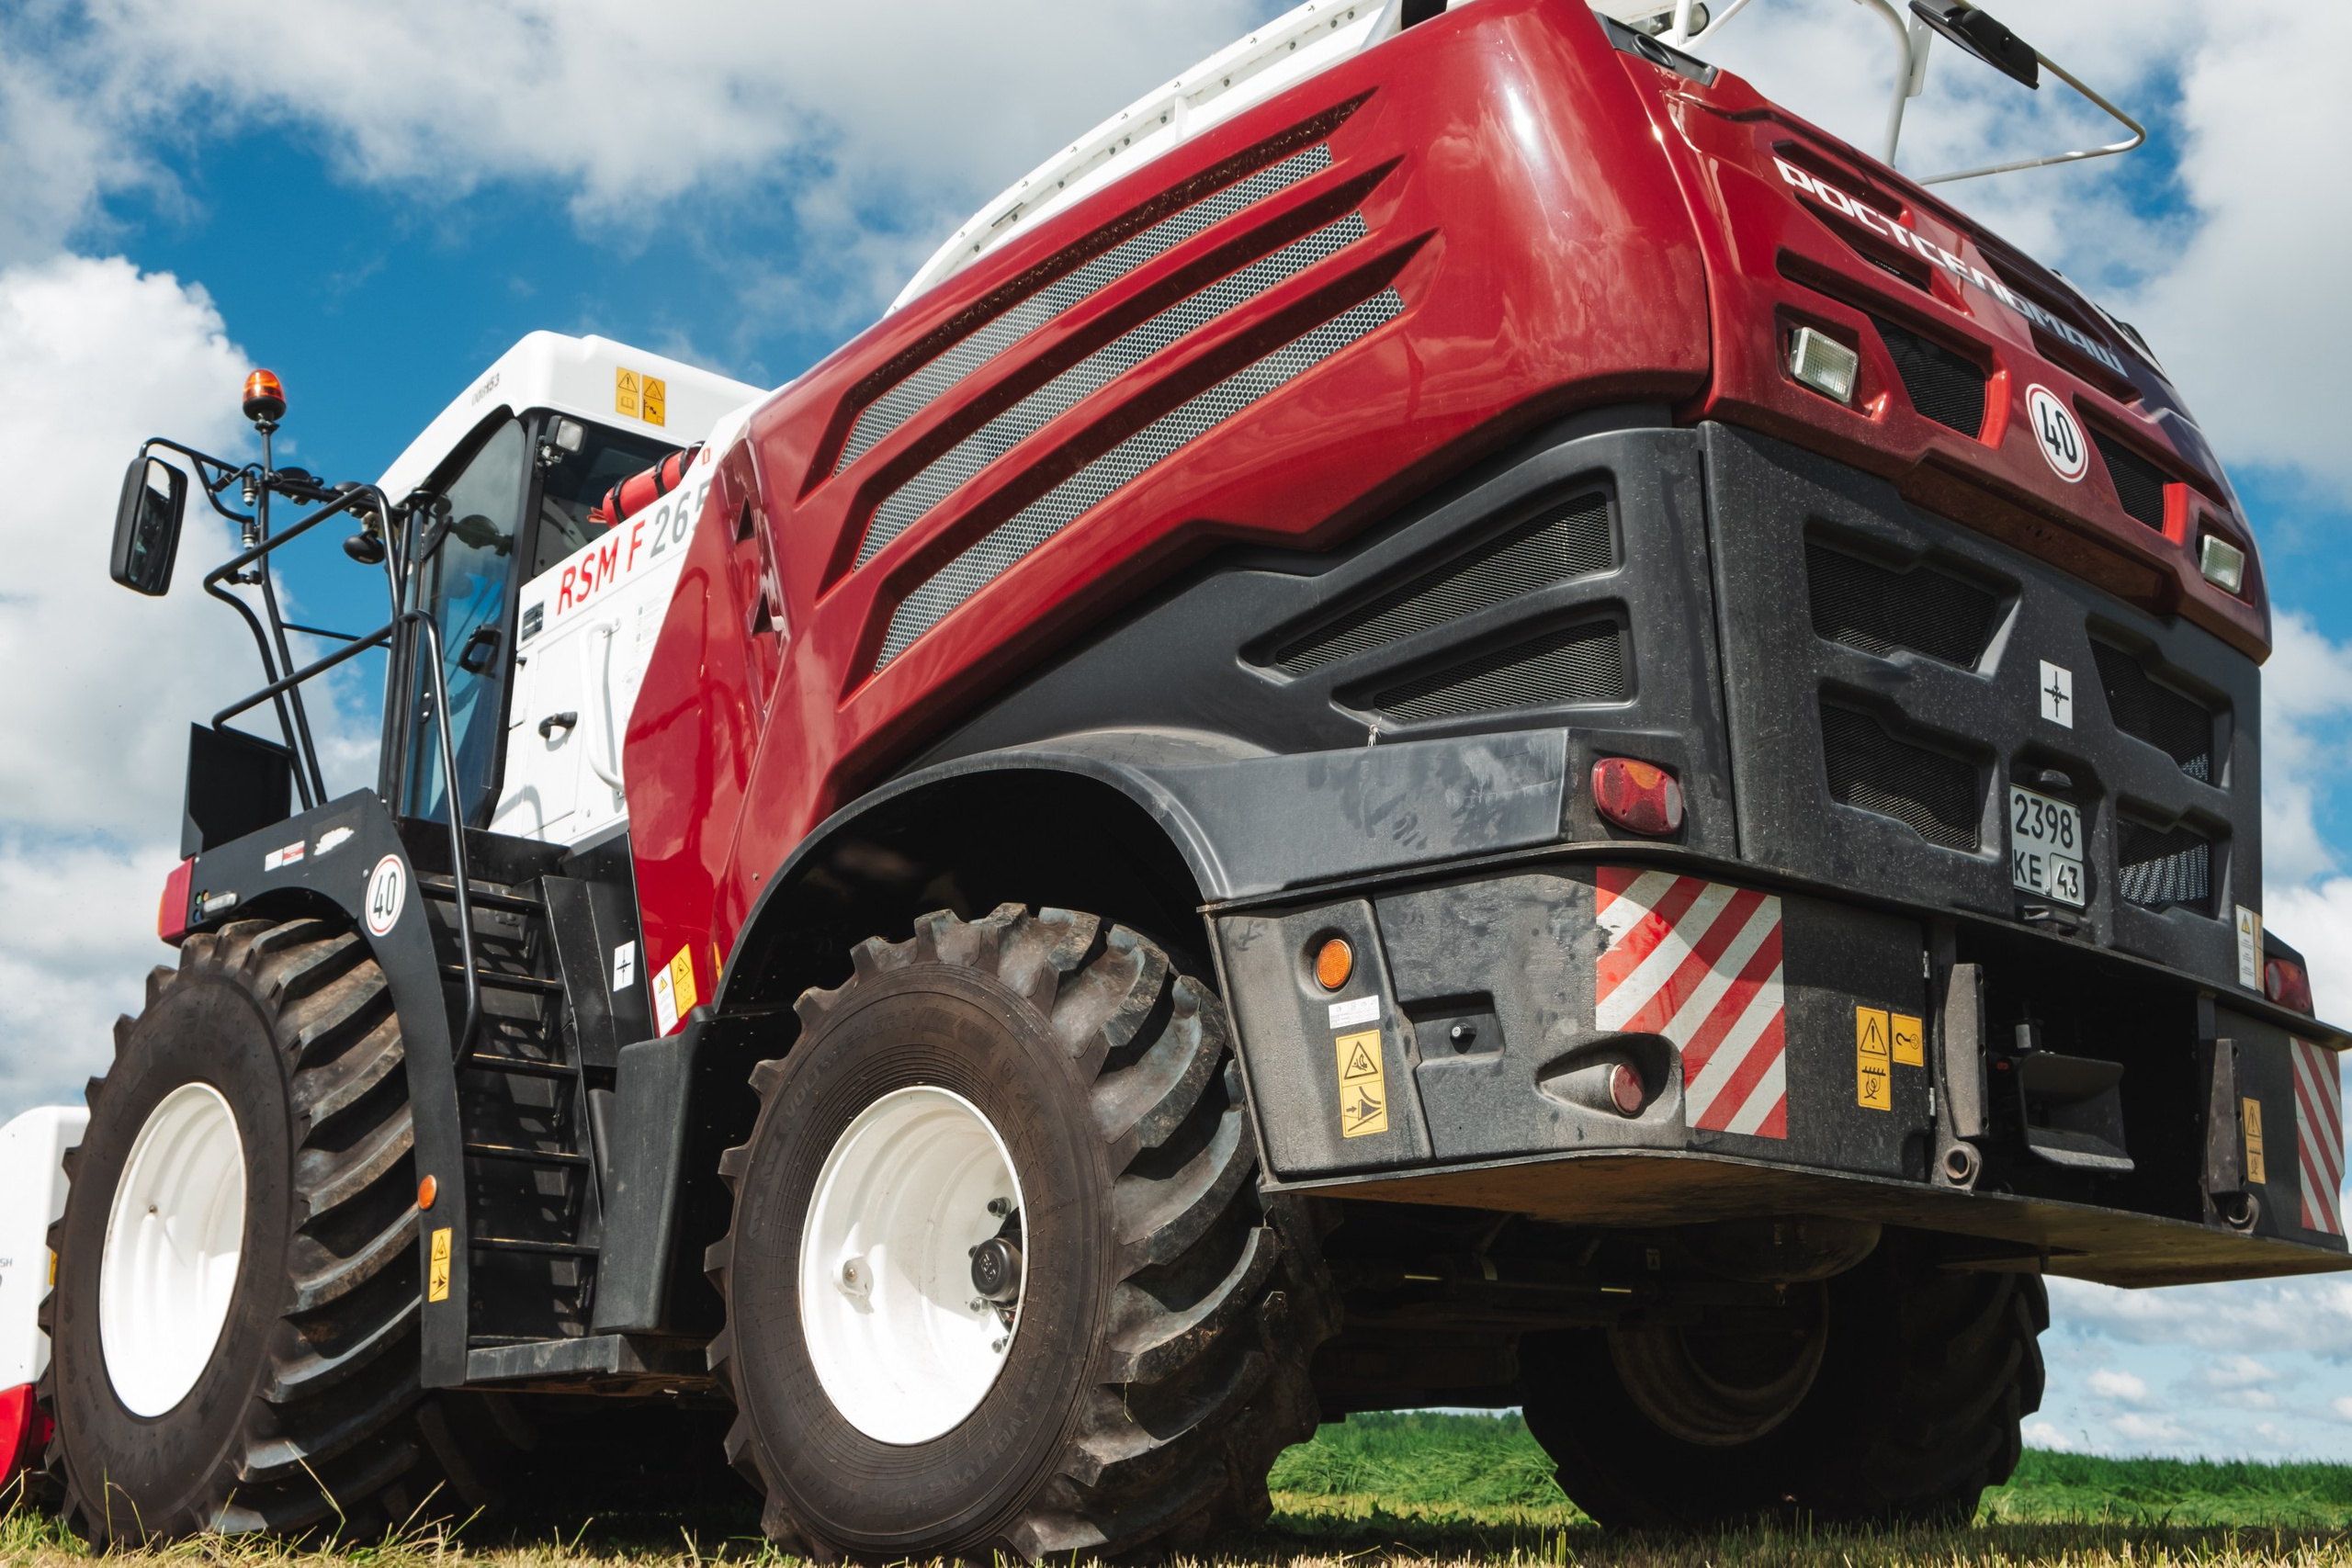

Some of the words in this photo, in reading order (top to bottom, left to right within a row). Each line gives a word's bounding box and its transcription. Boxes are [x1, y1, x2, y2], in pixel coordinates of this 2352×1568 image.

[1772, 156, 2129, 378] РОСТСЕЛЬМАШ
[2040, 400, 2077, 464] 40
[557, 536, 619, 615] RSM
[626, 519, 646, 573] F
[2015, 794, 2074, 849] 2398
[373, 871, 397, 919] 40
[2056, 863, 2078, 898] 43
